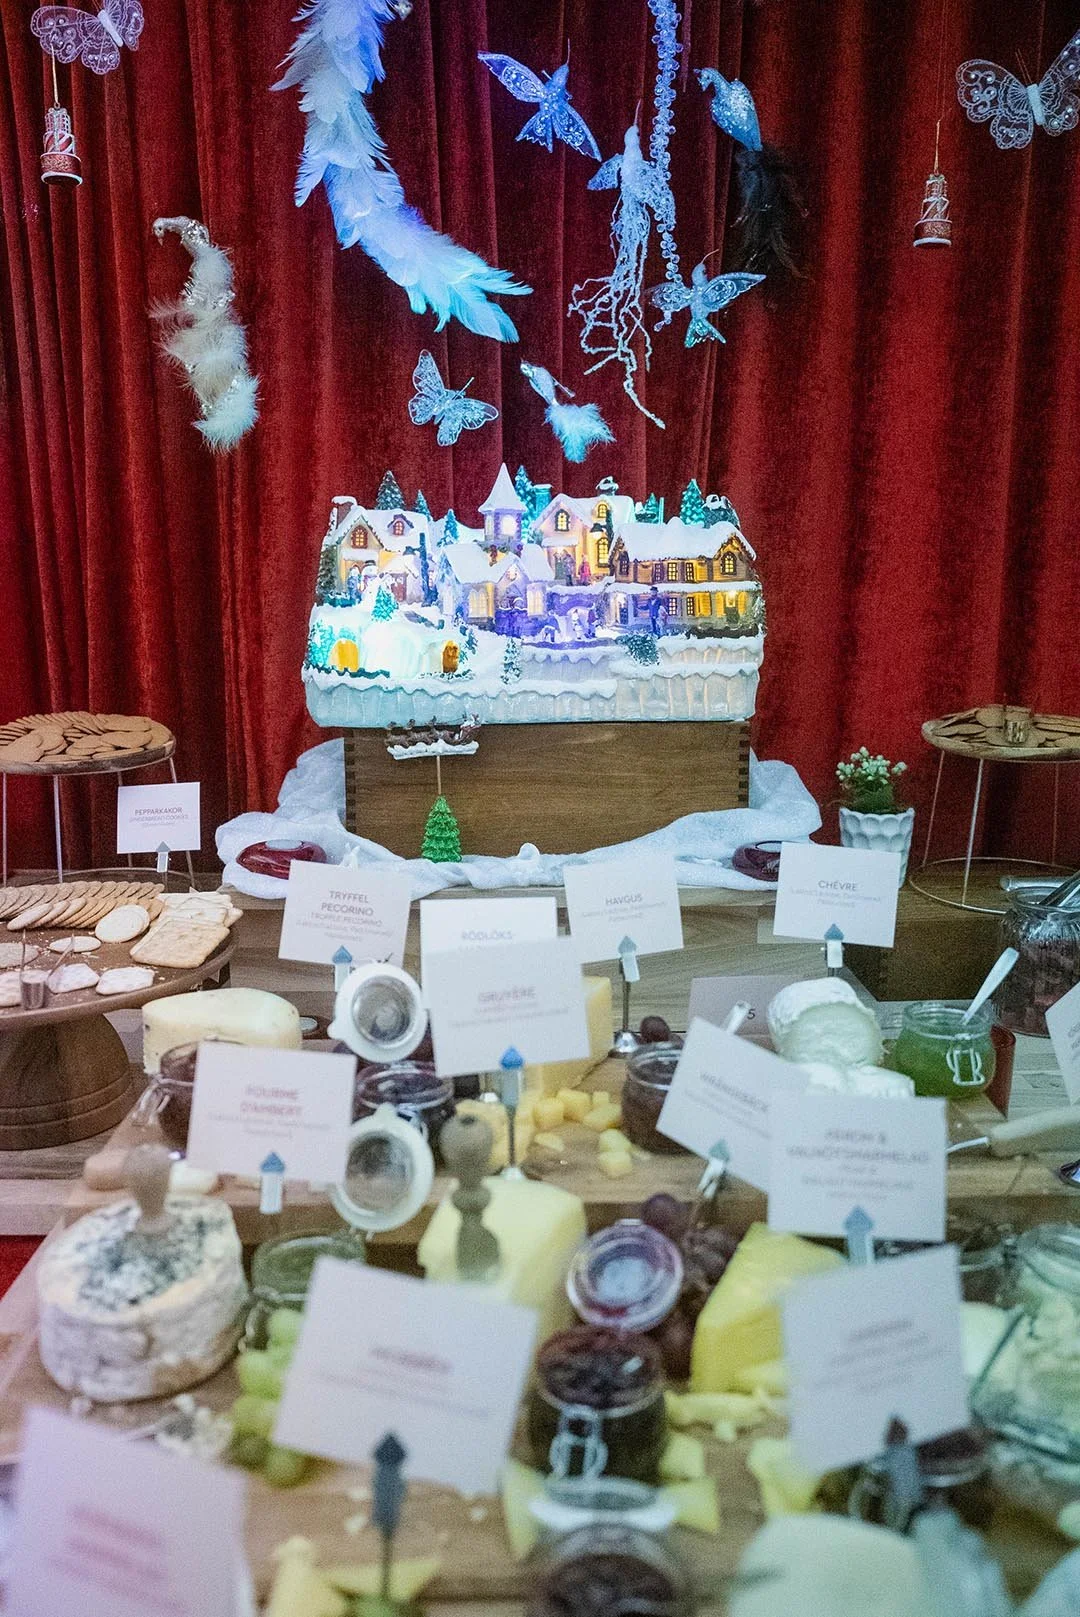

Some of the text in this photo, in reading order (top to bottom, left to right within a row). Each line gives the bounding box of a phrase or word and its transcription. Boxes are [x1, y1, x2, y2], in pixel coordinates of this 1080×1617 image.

[134, 807, 182, 816] PEPPARKAKOR
[329, 890, 369, 904] TRYFFEL
[605, 893, 643, 906] HAVGUS
[321, 902, 374, 917] PECORINO
